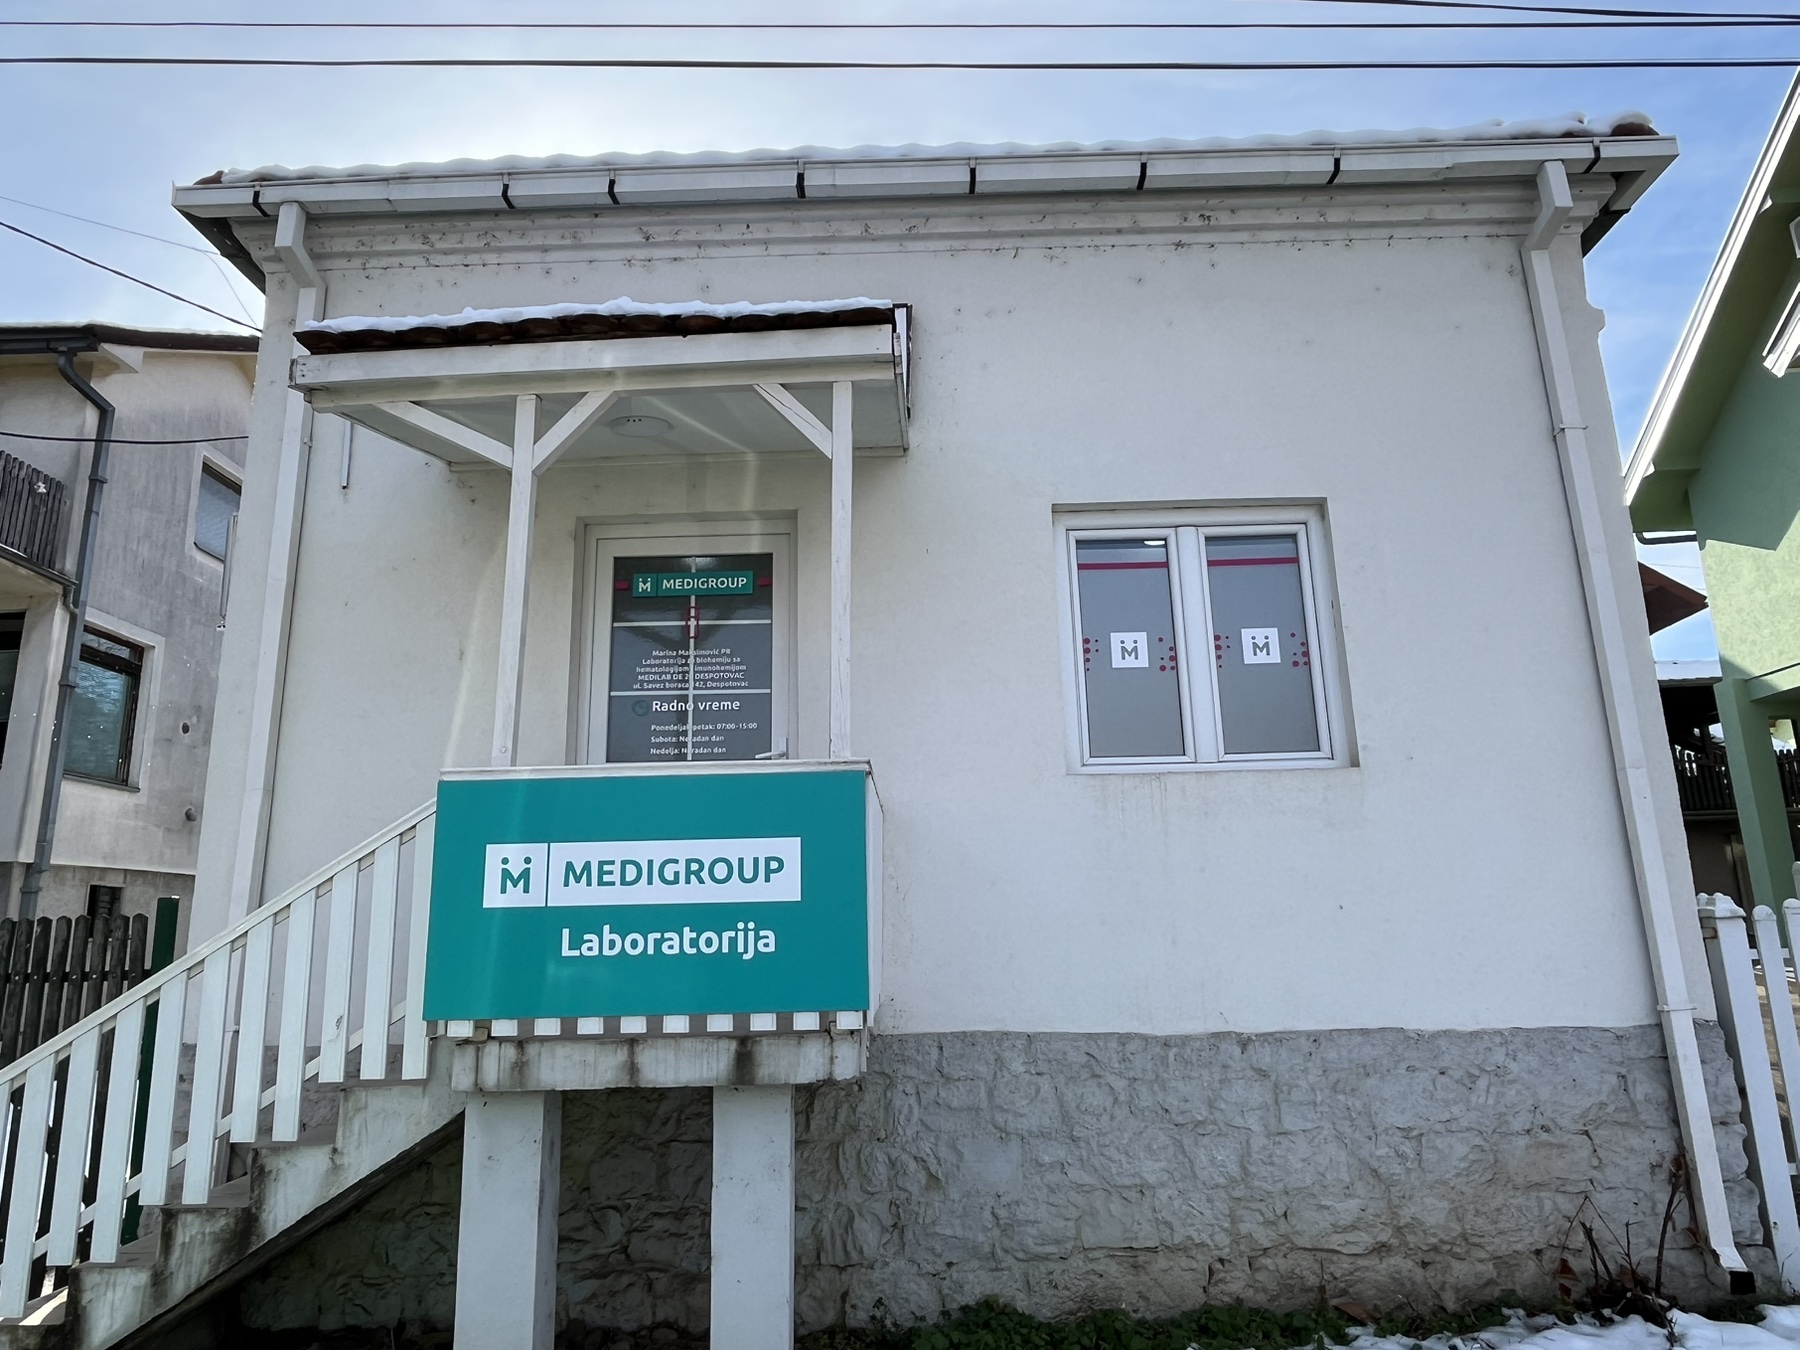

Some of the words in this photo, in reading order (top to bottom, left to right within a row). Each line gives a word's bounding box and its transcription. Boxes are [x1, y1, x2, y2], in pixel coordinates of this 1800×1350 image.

[662, 577, 747, 590] MEDIGROUP
[642, 657, 686, 665] Laboratorija
[696, 656, 731, 664] biohemiju
[636, 665, 690, 673] hematologijom
[694, 664, 747, 672] imunohemijom
[694, 671, 745, 680] DESPOTOVAC
[665, 681, 690, 689] boraca
[706, 680, 749, 689] Despotovac
[652, 699, 694, 712] Radno
[697, 701, 741, 711] vreme
[679, 735, 710, 743] Neadan
[710, 734, 725, 742] dan
[650, 747, 680, 756] Nedelja:
[681, 746, 712, 754] Nradan
[562, 856, 785, 888] MEDIGROUP
[560, 921, 776, 960] Laboratorija
